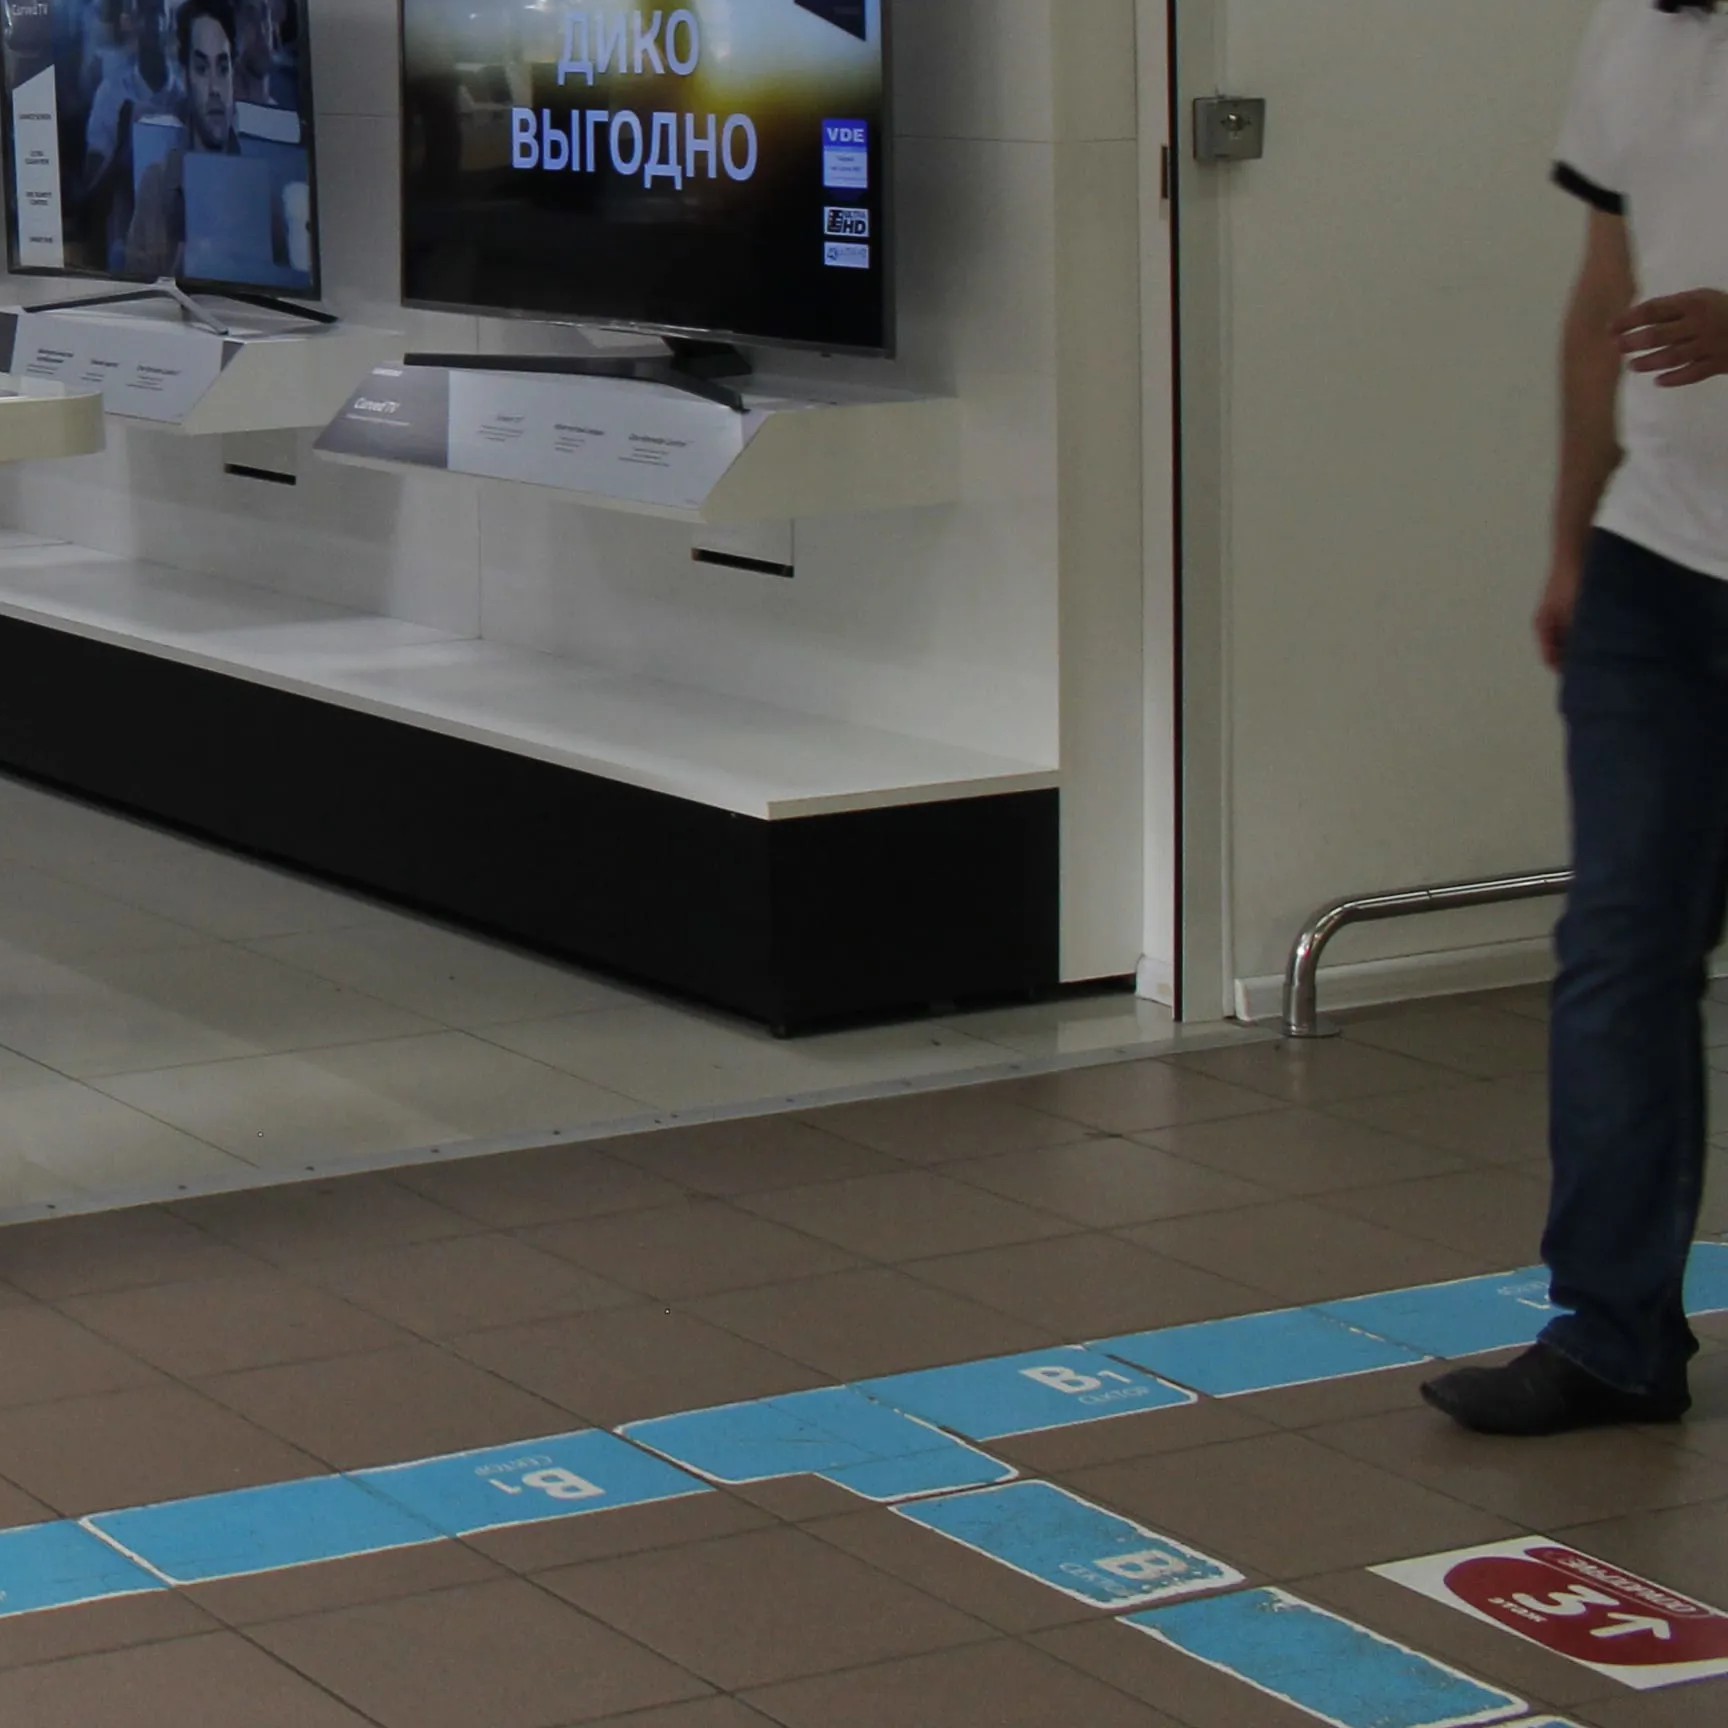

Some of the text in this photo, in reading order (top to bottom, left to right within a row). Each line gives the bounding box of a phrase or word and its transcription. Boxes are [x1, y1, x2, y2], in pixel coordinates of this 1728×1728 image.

[557, 9, 700, 86] ДИКО
[512, 108, 758, 190] ВЫГОДНО
[827, 127, 865, 142] VDE
[1018, 1366, 1133, 1394] B1
